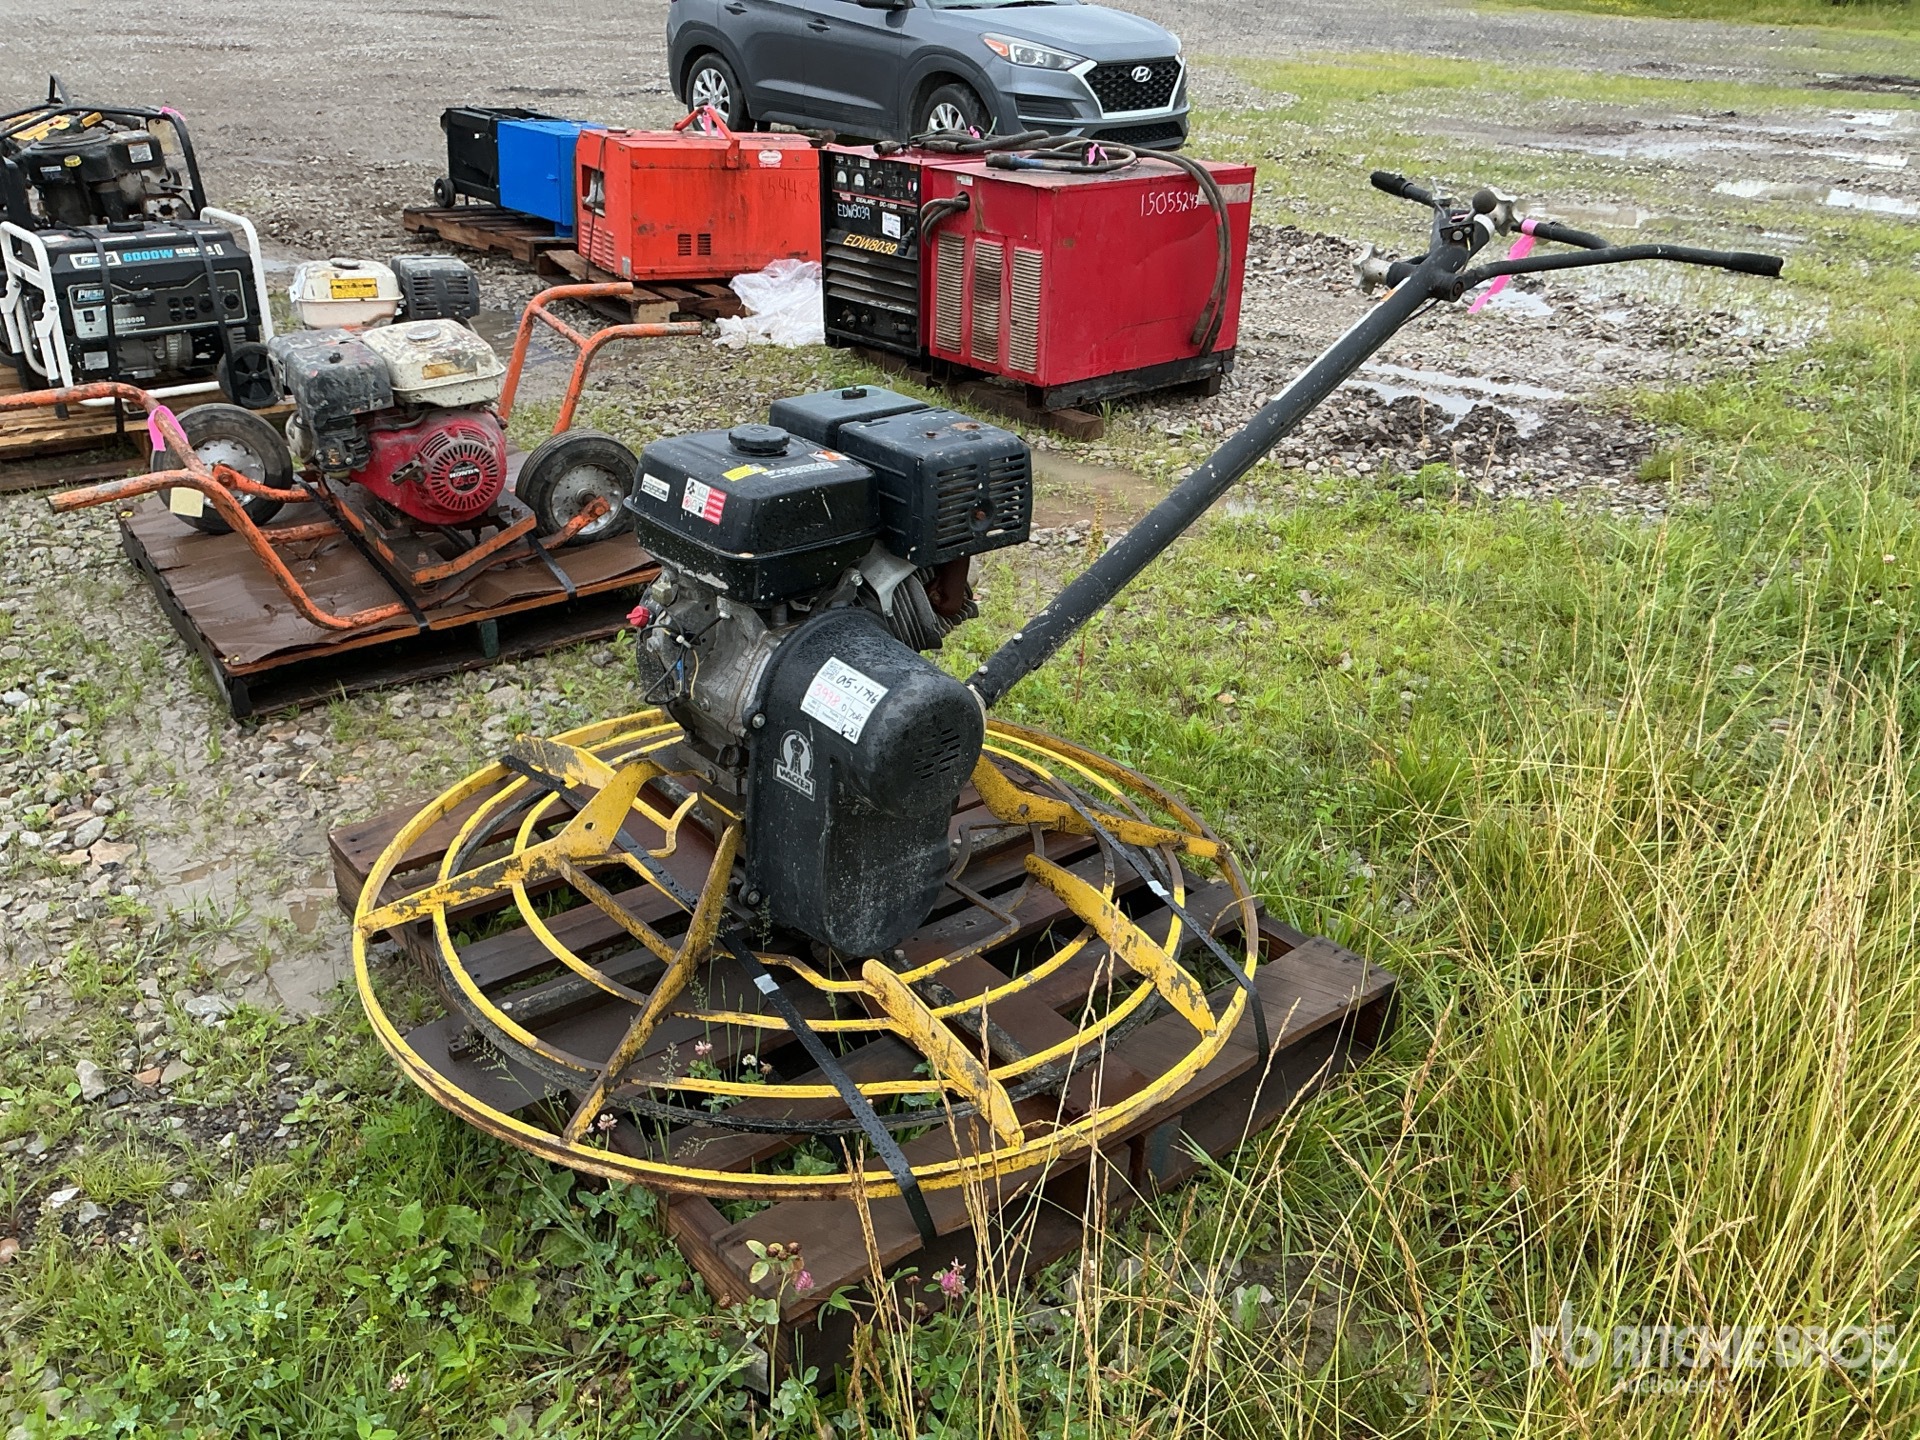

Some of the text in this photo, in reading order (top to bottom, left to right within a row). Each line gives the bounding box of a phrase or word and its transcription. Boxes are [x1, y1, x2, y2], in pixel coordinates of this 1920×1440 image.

[843, 234, 898, 254] EDW8039
[123, 249, 174, 262] 6000W
[449, 468, 480, 479] HONDA
[779, 767, 811, 792] WACKER
